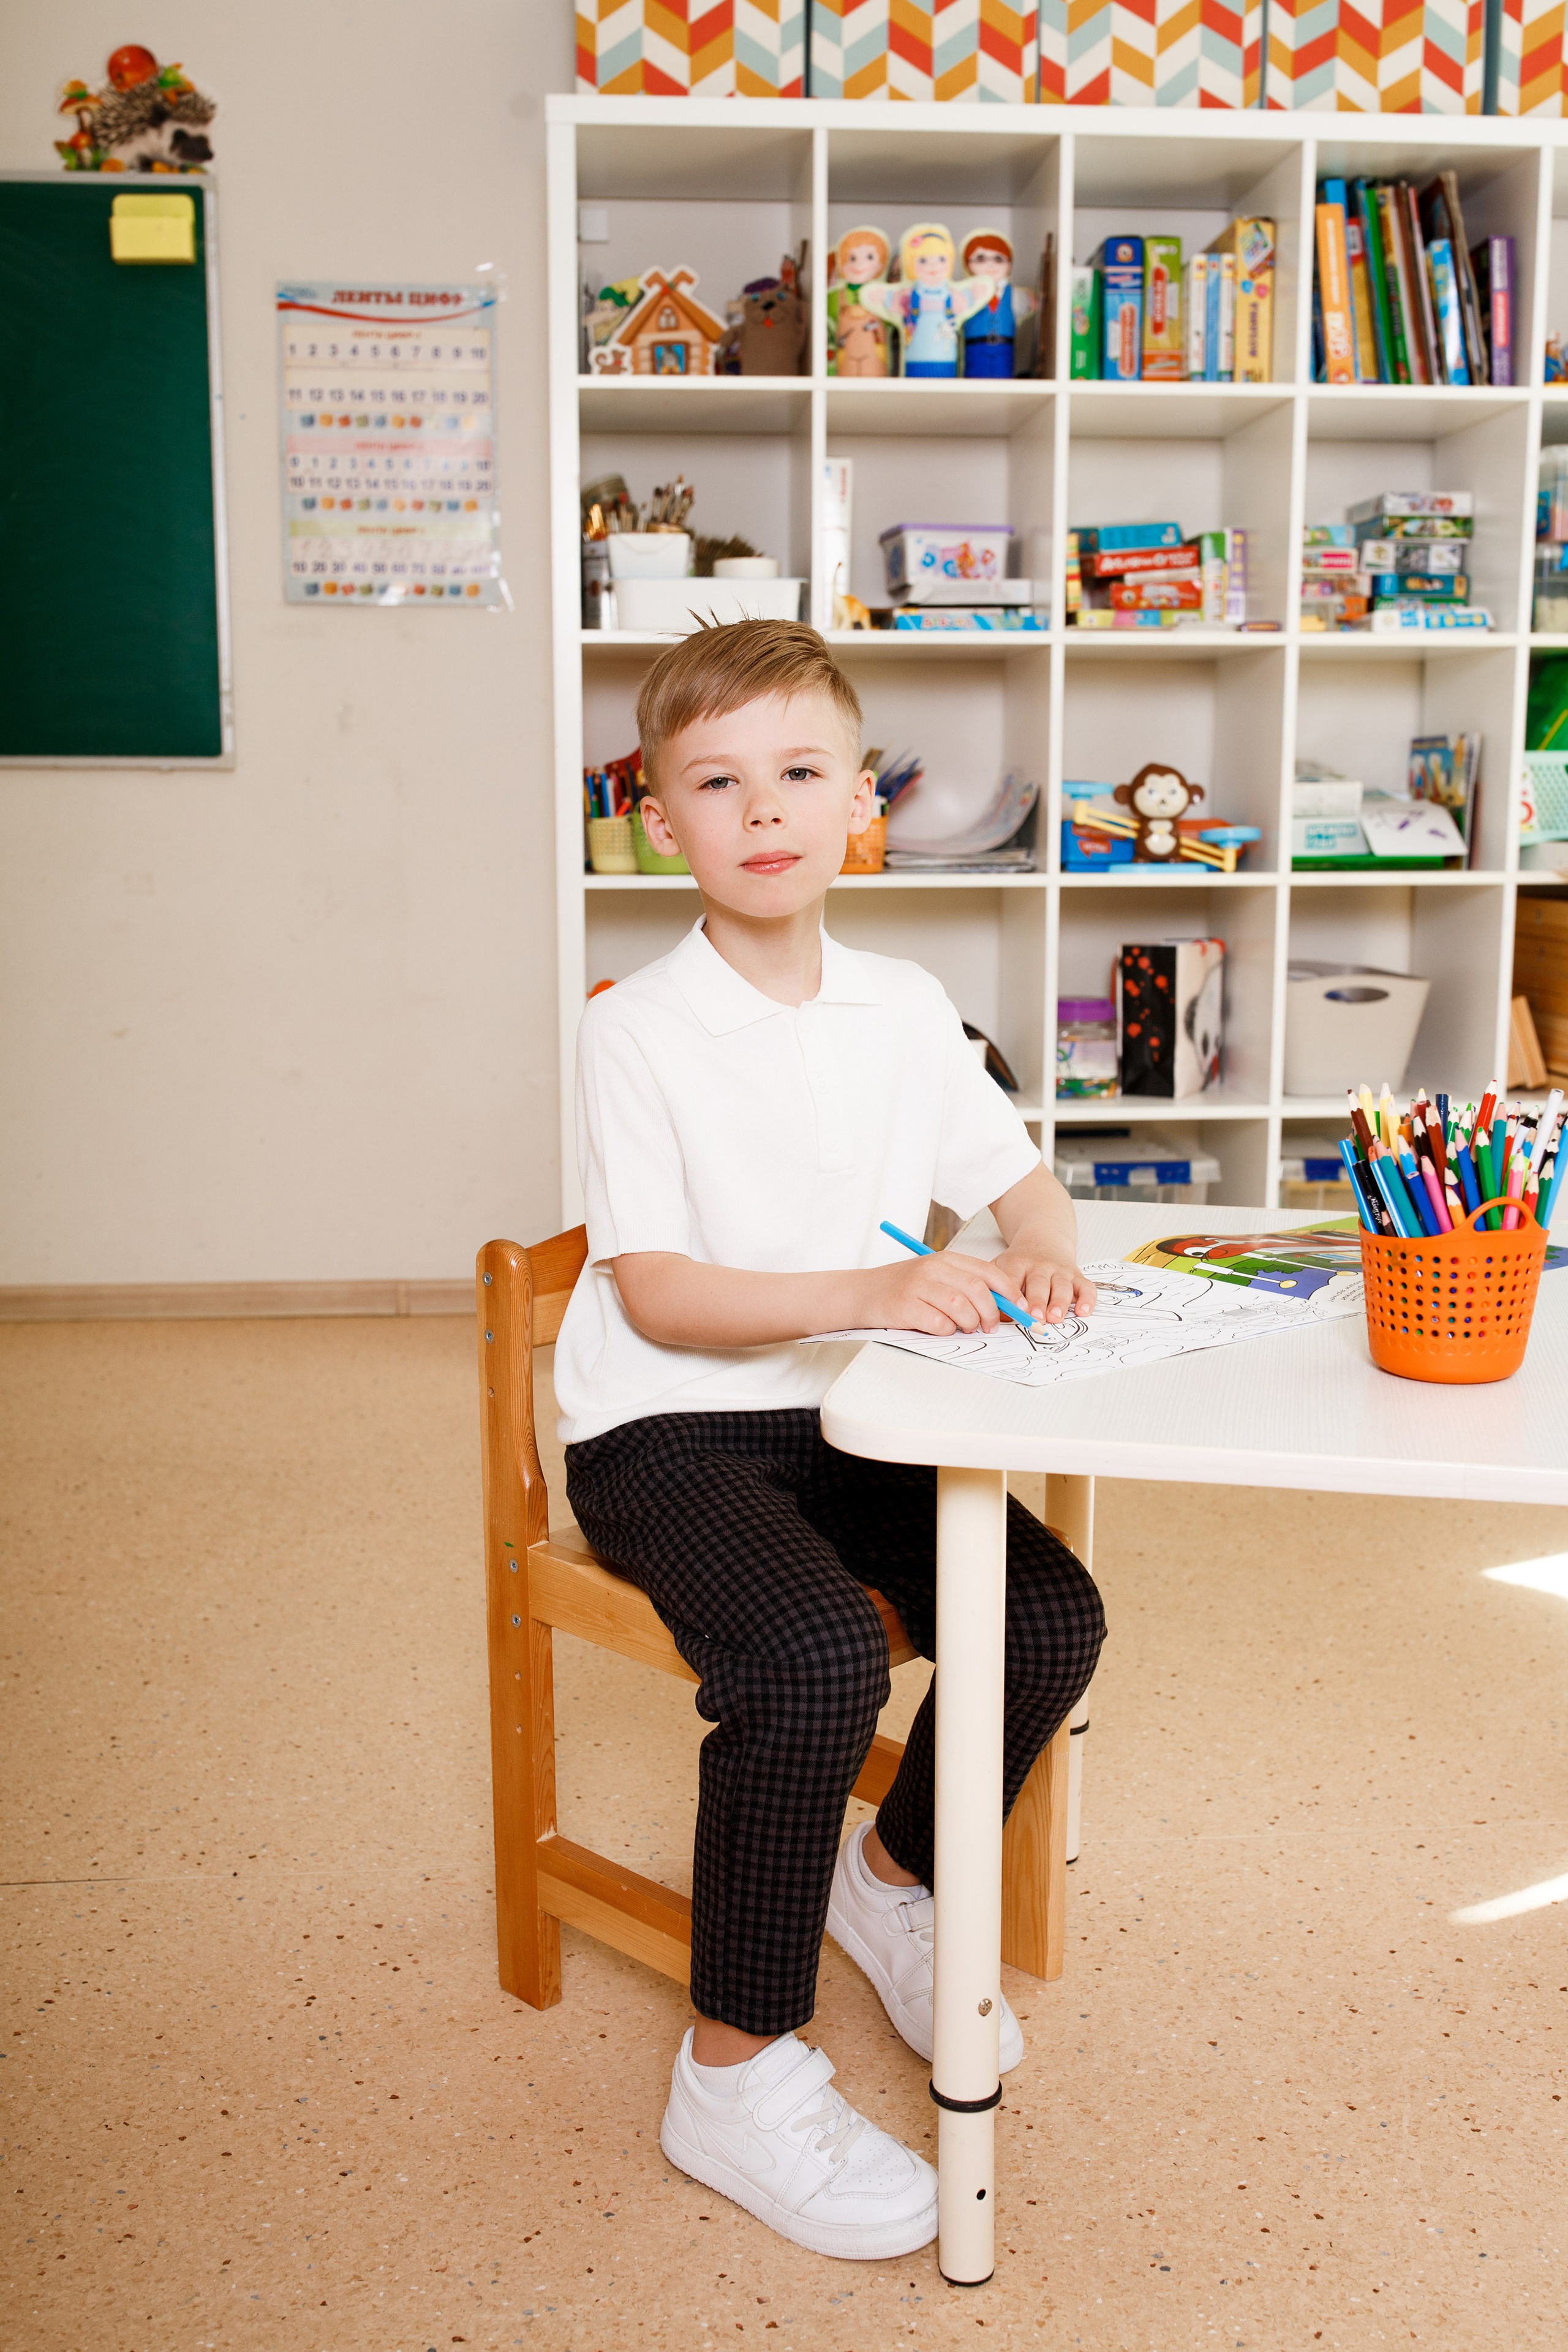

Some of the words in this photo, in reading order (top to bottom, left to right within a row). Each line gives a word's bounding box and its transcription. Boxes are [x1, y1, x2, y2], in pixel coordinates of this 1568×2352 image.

[331, 290, 404, 304] ЛЕНТЫ
[408, 292, 463, 307] ЦИФР
[288, 343, 296, 356] 1
[309, 344, 317, 356] 2
[330, 344, 339, 357] 3
[350, 344, 359, 357] 4
[371, 345, 379, 358] 5
[391, 345, 400, 358] 6
[412, 345, 420, 358] 7
[432, 346, 441, 359] 8
[453, 346, 462, 359] 9
[471, 347, 486, 360] 10
